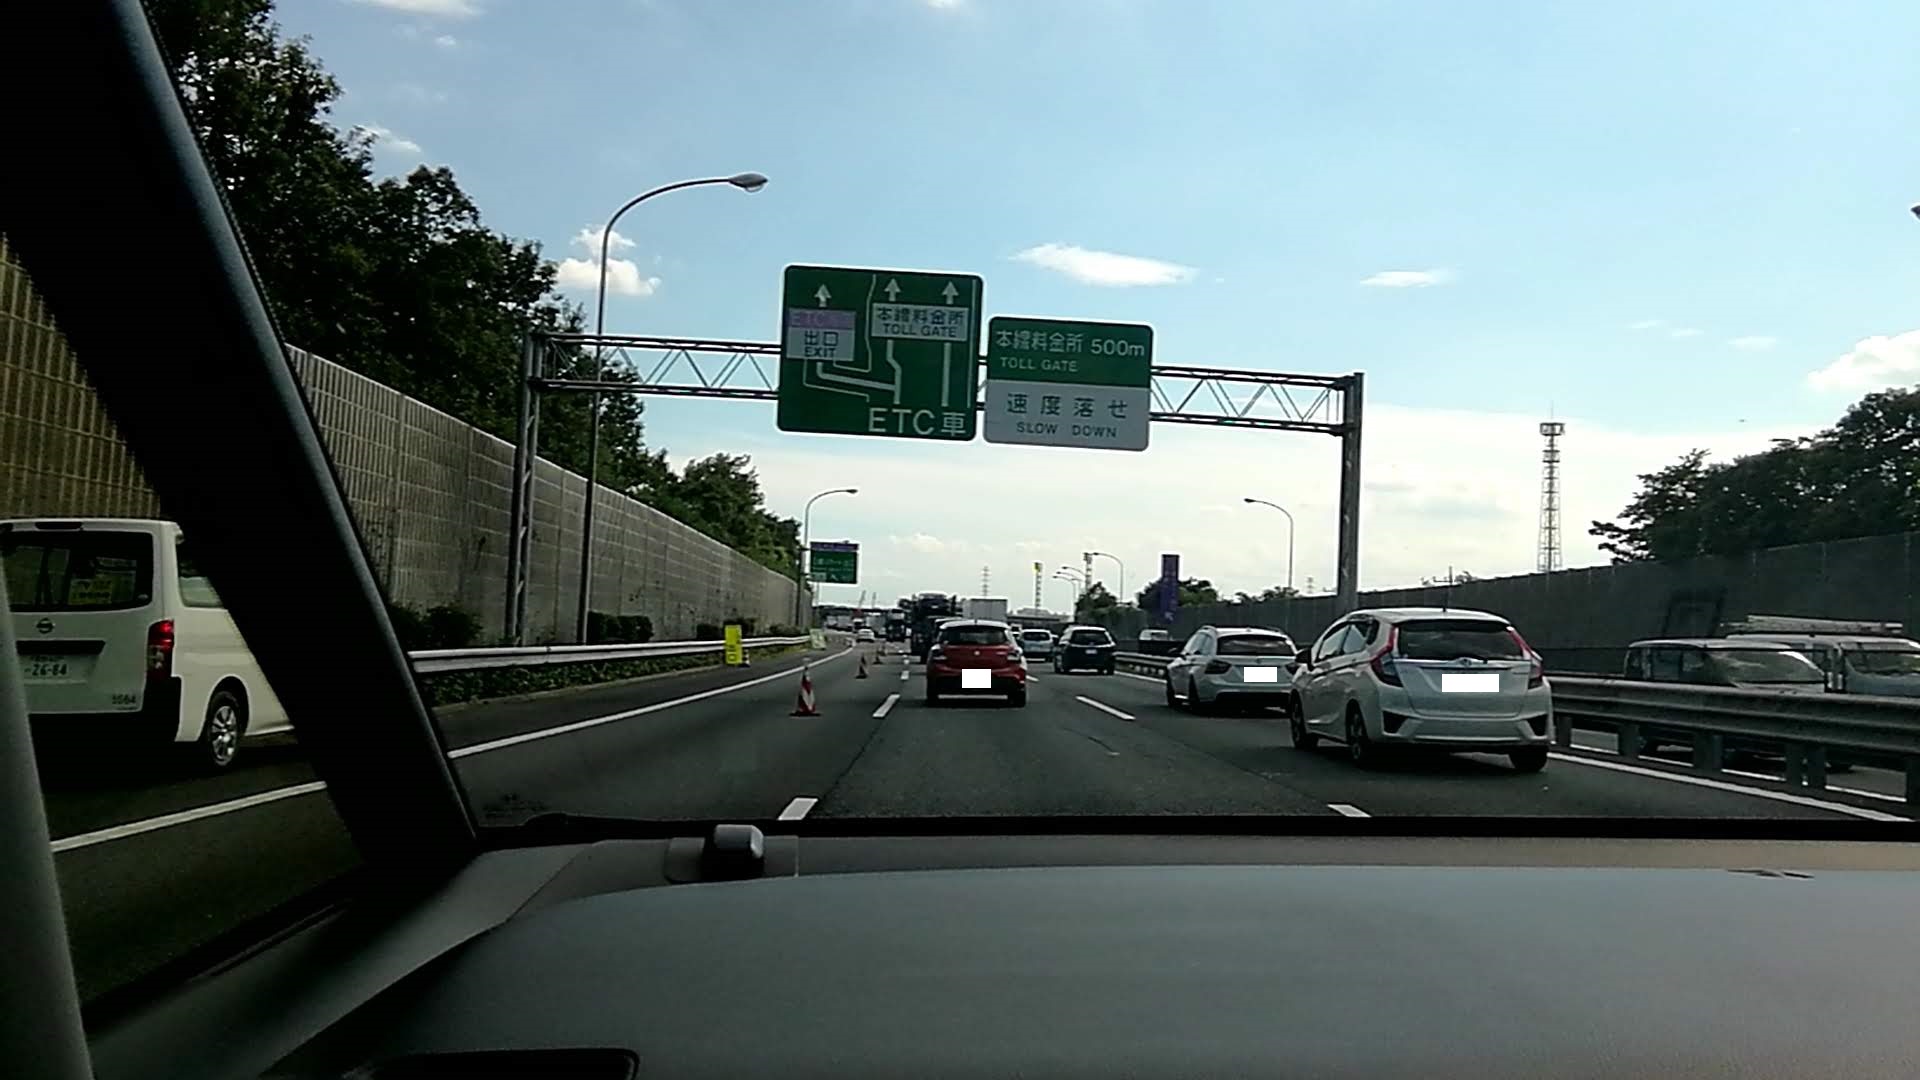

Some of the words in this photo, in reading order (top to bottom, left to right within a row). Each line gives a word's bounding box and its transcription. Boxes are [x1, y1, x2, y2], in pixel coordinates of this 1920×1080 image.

[805, 330, 839, 346] 出口
[883, 323, 917, 336] TOLL
[921, 325, 957, 338] GATE
[805, 346, 835, 357] EXIT
[1091, 338, 1145, 357] 500m
[1000, 356, 1036, 369] TOLL
[1041, 359, 1078, 372] GATE
[1007, 393, 1128, 419] 速度落せ
[1016, 421, 1059, 434] SLOW
[1072, 424, 1117, 438] DOWN
